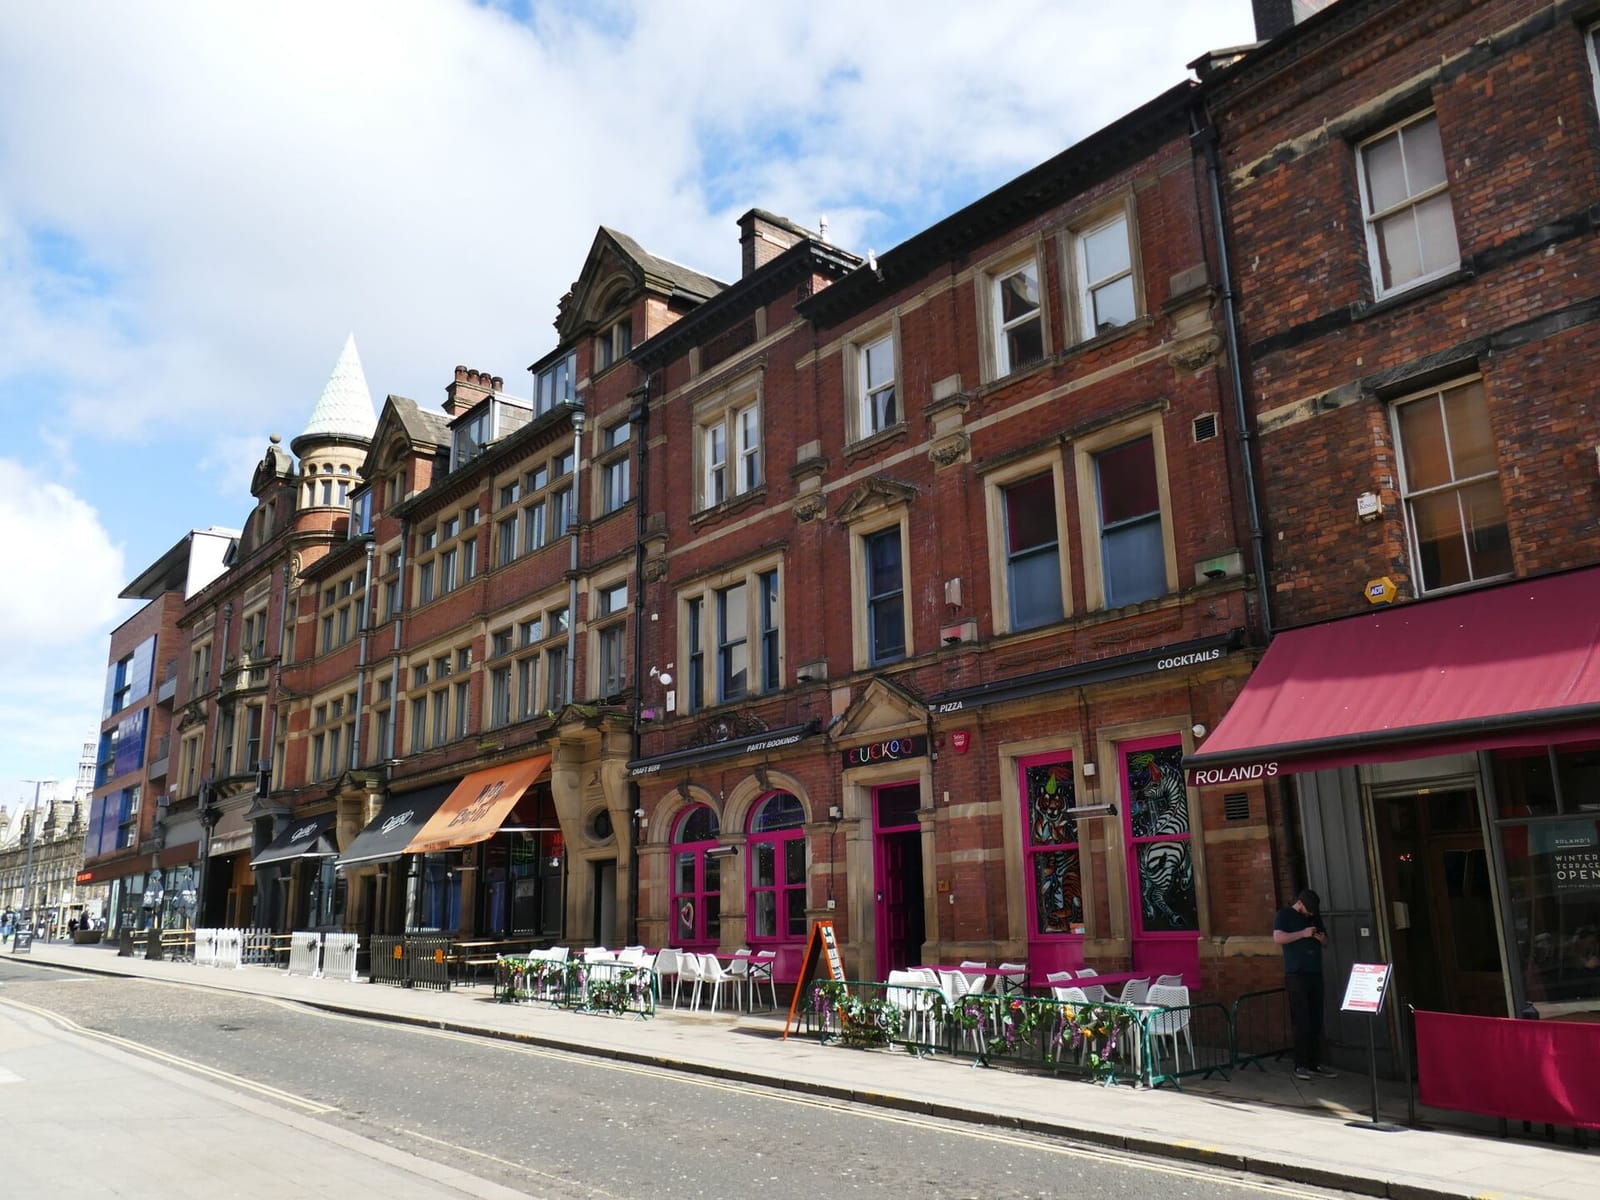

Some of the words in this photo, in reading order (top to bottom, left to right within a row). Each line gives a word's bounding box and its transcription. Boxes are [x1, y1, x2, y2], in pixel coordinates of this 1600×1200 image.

[1157, 648, 1220, 670] COCKTAILS
[940, 701, 963, 713] PIZZA
[746, 741, 767, 752] PARTY
[766, 735, 800, 748] BOOKINGS
[849, 738, 913, 763] CUCKOO
[632, 766, 648, 776] CRAFT
[1195, 762, 1278, 785] ROLAND'S
[1555, 854, 1598, 862] WINTER
[1557, 870, 1600, 880] OPEN
